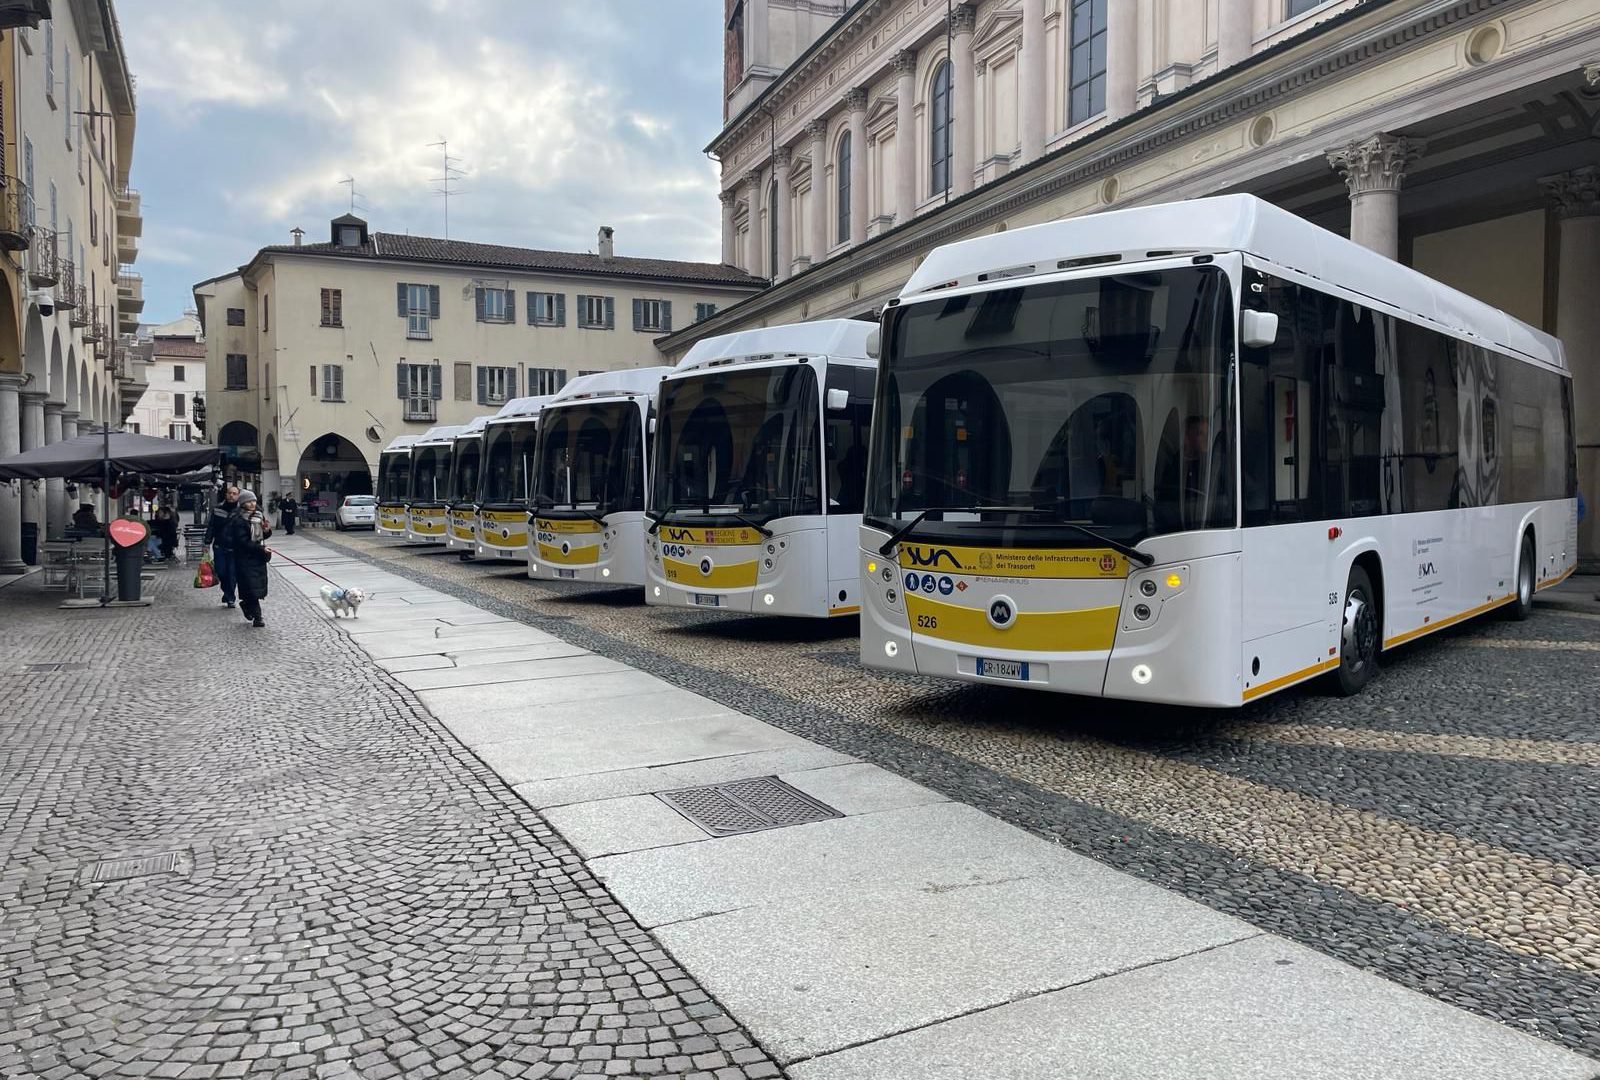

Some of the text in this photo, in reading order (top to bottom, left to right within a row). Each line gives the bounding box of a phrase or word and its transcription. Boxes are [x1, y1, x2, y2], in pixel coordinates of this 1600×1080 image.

[1027, 554, 1043, 562] delle
[1328, 591, 1338, 605] 526
[917, 615, 937, 629] 526
